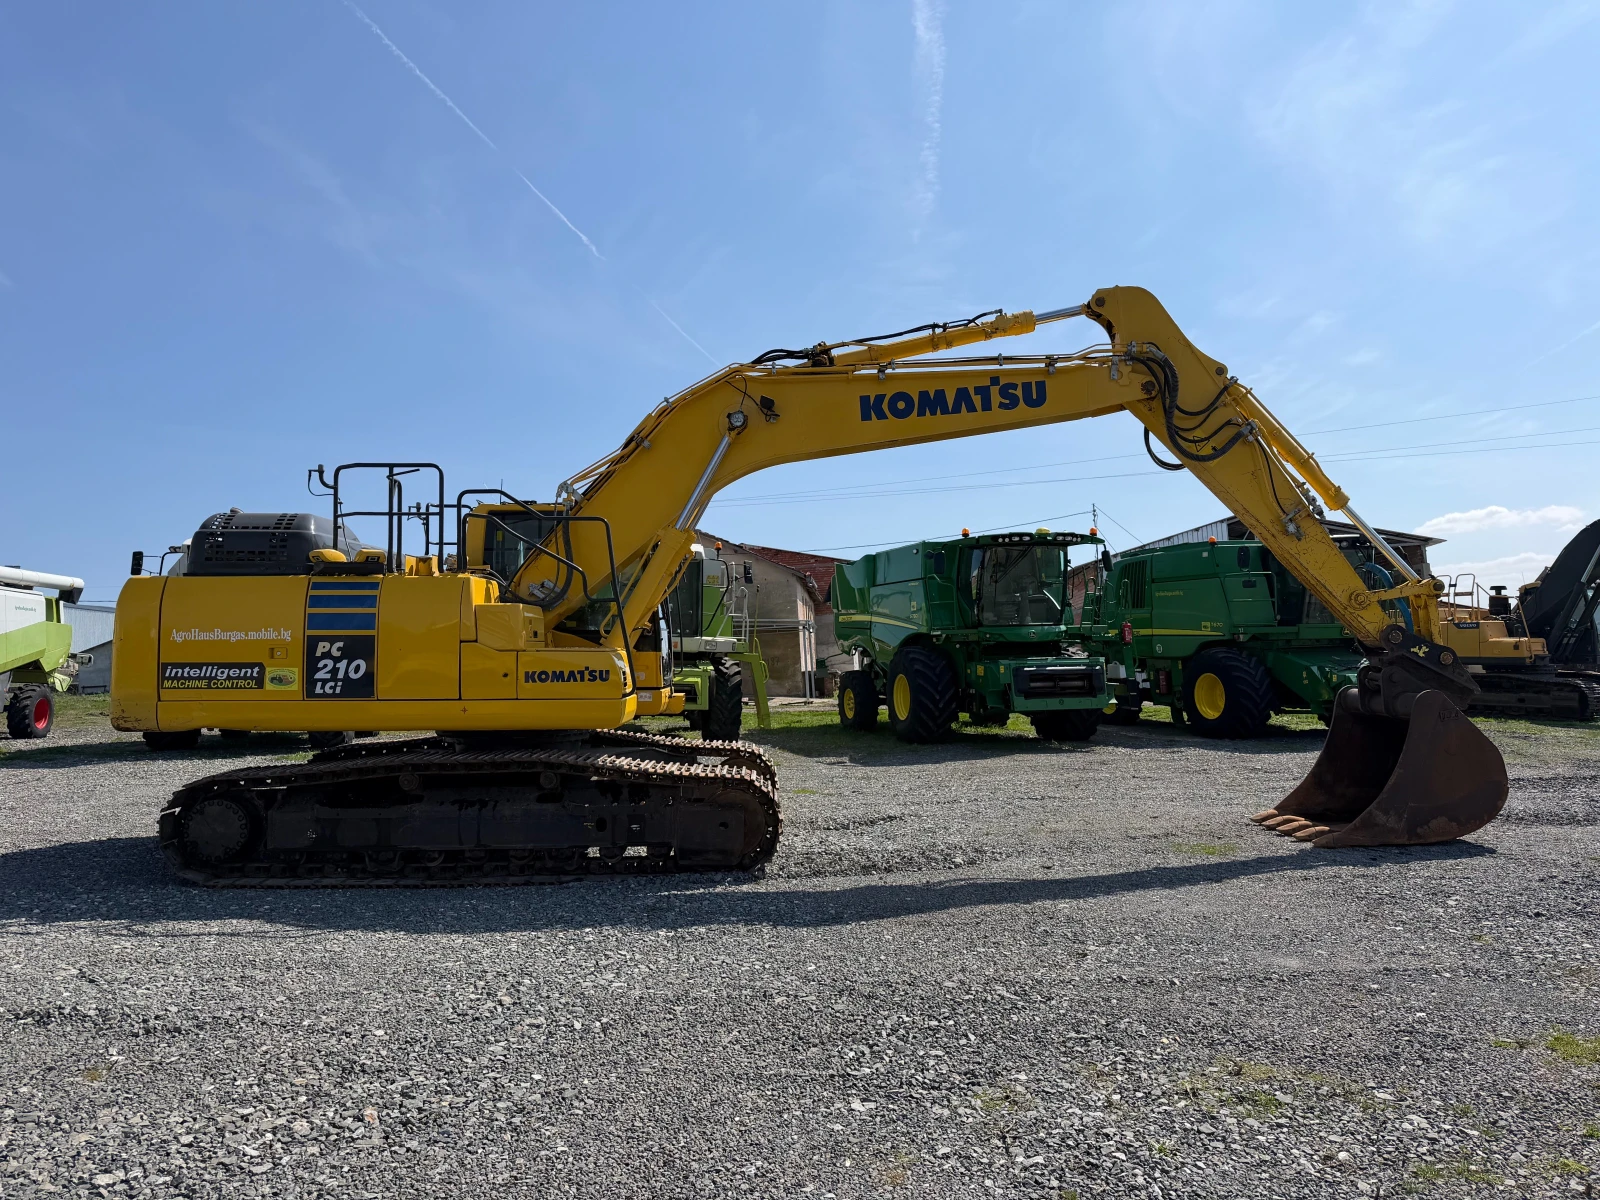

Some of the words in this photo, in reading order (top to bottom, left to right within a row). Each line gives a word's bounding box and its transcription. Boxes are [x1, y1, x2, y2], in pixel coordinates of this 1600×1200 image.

[859, 376, 1047, 422] KOMATSU
[170, 628, 292, 643] AgroHausBurgas.mobile.bg
[315, 641, 344, 657] PC
[165, 666, 259, 679] intelligent
[314, 658, 367, 680] 210
[524, 666, 610, 684] KOMATSU
[163, 679, 209, 688] MACHINE
[211, 679, 258, 688] CONTROL
[314, 681, 342, 694] LCi
